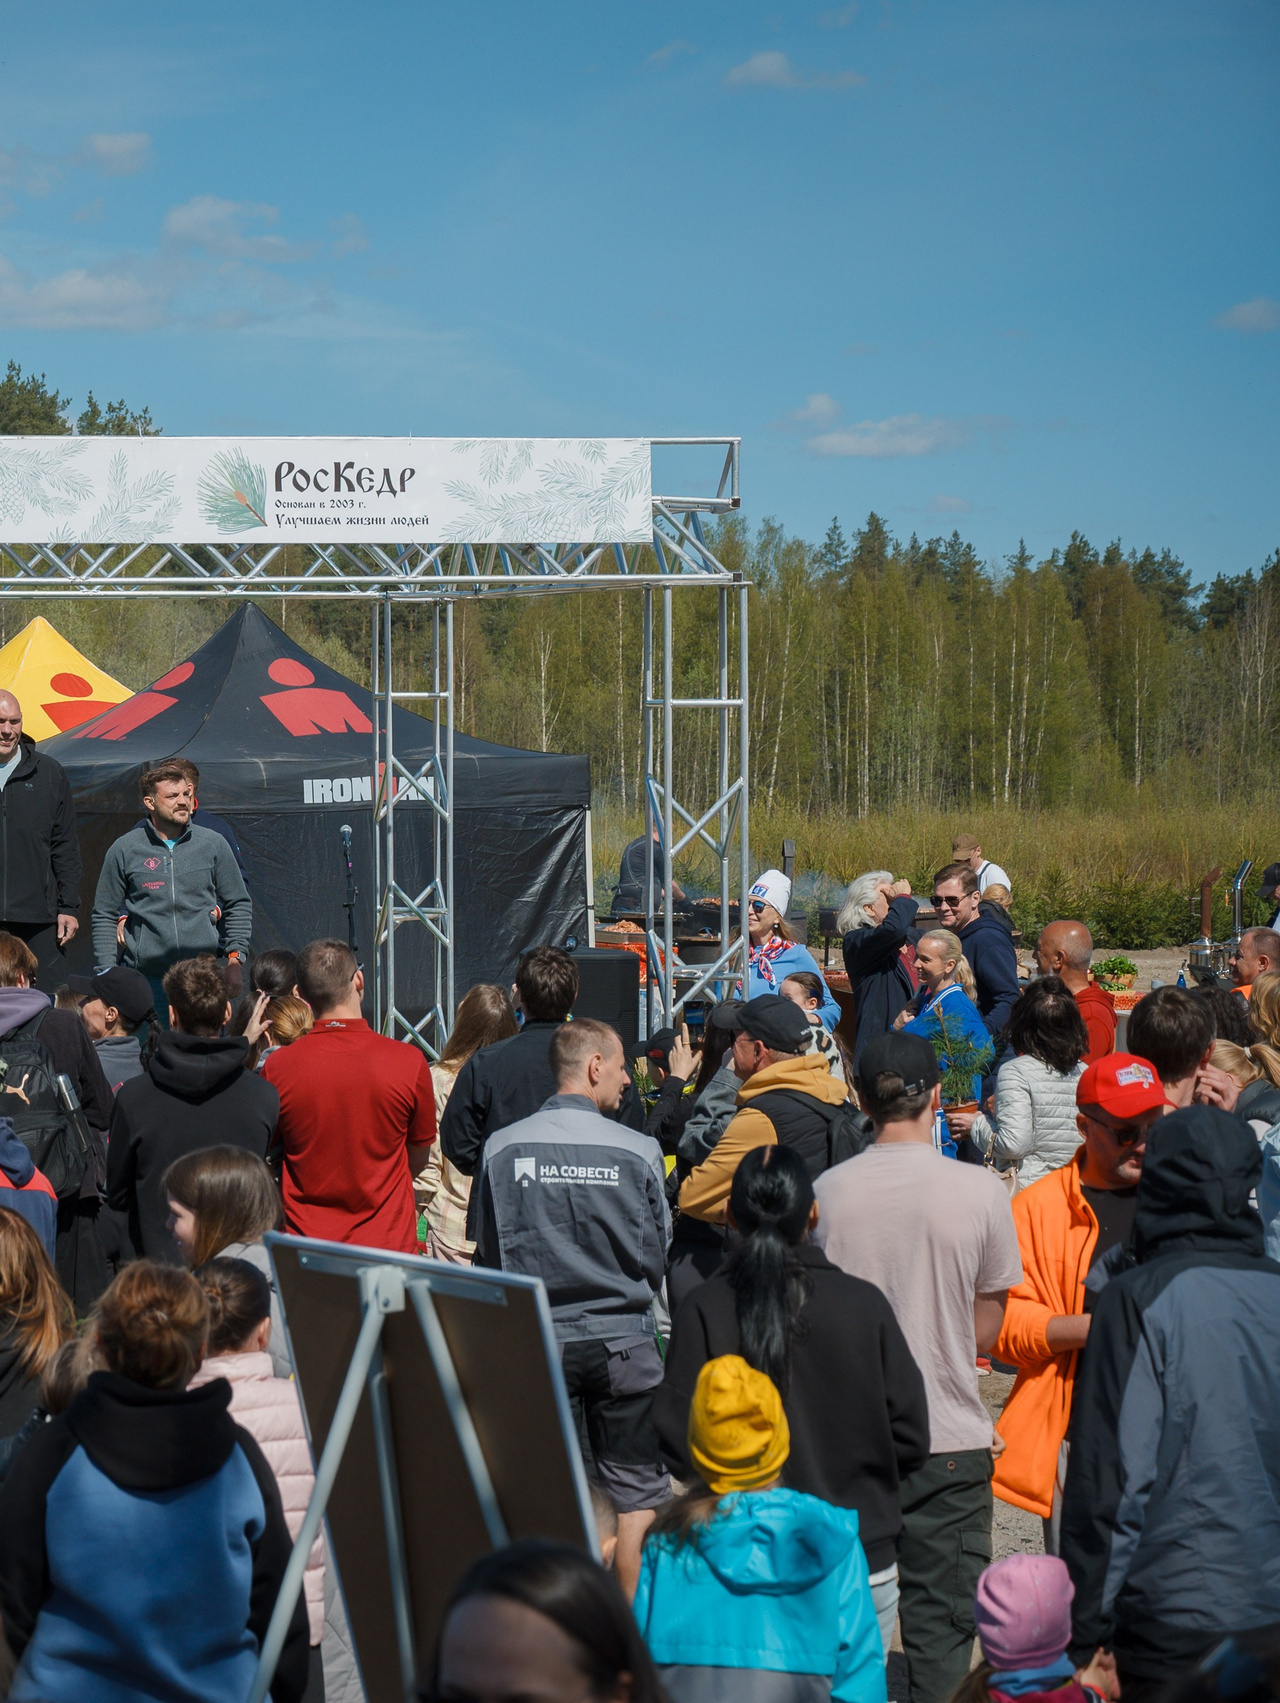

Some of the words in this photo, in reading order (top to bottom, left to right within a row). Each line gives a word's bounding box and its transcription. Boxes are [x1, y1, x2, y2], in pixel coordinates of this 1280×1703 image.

[274, 499, 316, 509] Основан
[319, 501, 326, 509] в
[329, 499, 355, 509] 2003
[358, 501, 367, 509] г.
[275, 513, 342, 528] Улучшаем
[346, 515, 386, 525] жизни
[390, 515, 429, 527] людей
[540, 1165, 559, 1177] НА
[560, 1165, 619, 1180] СОВЕСТЬ
